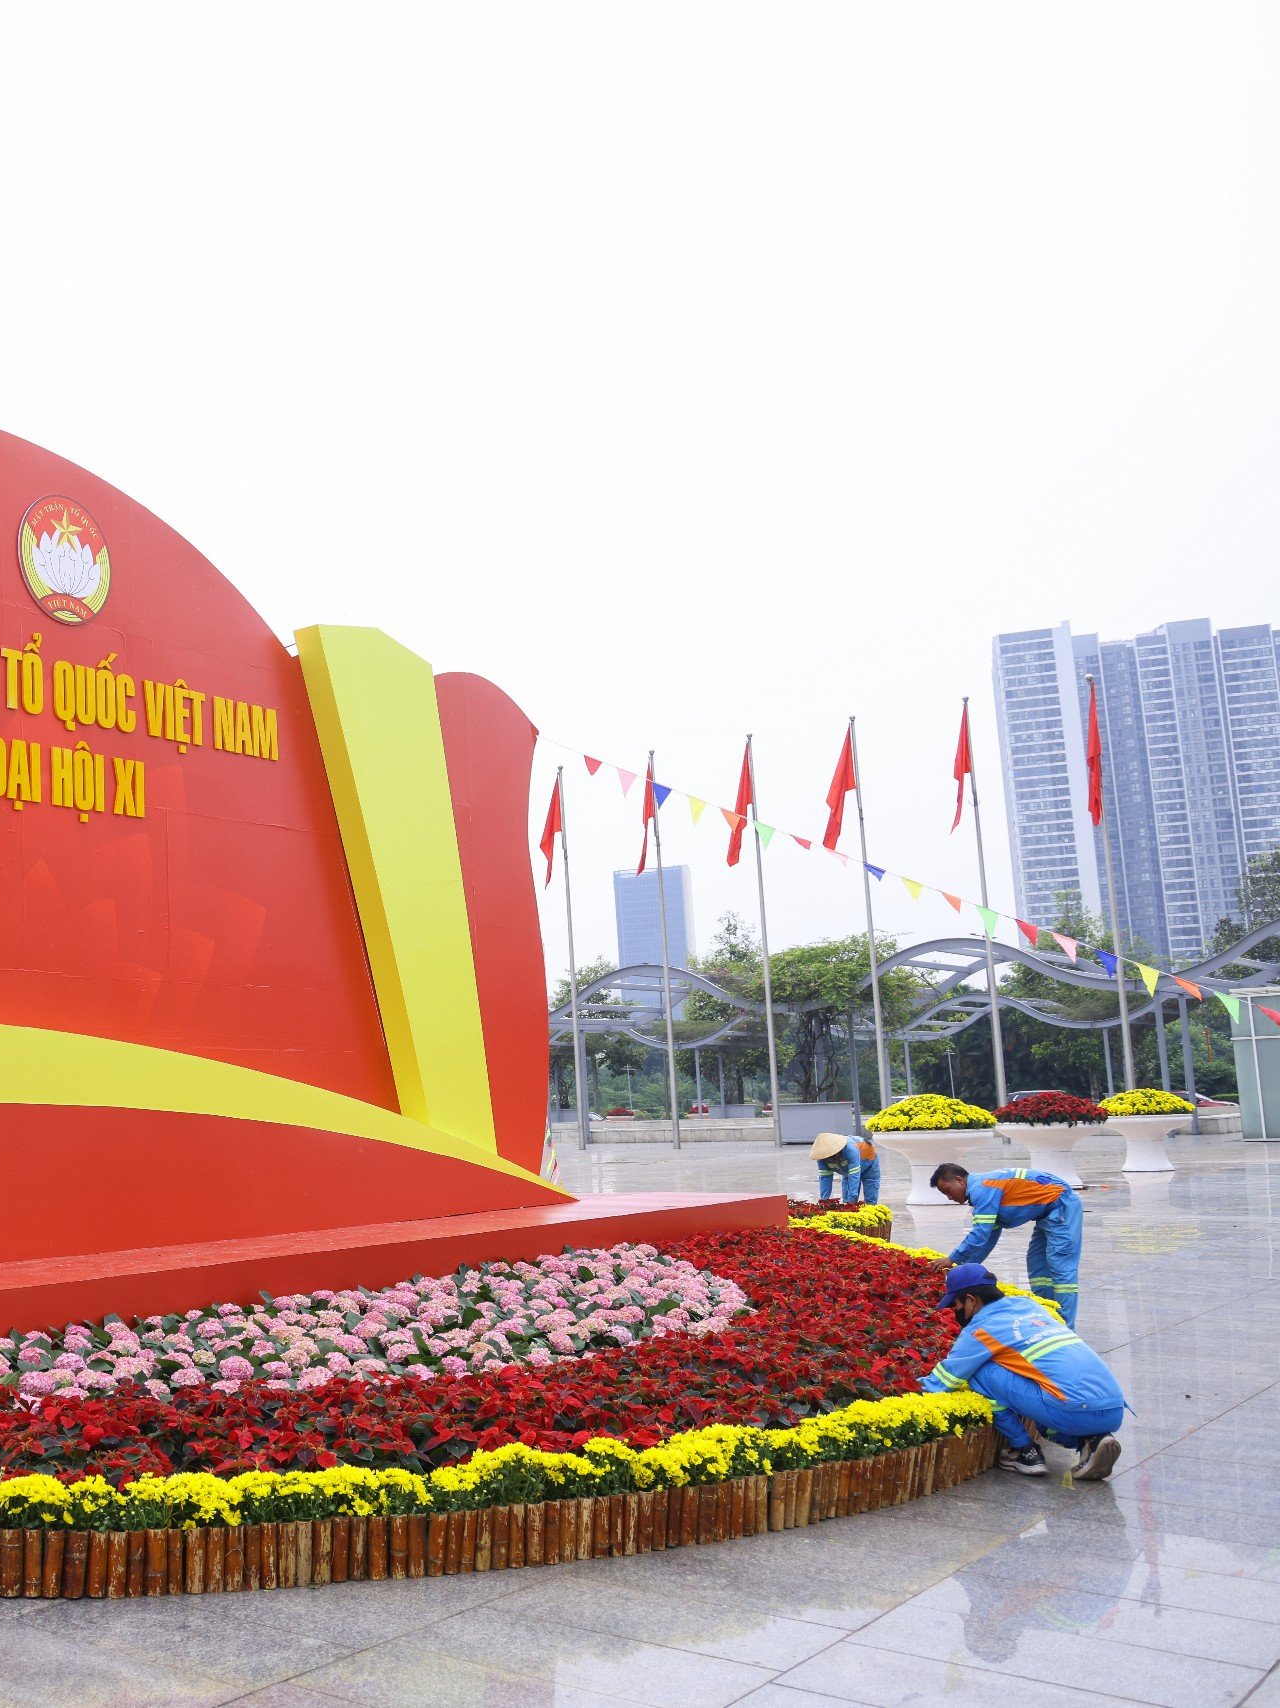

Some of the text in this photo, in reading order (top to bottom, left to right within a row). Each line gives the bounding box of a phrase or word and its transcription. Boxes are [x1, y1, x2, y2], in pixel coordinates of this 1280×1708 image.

[47, 597, 87, 618] VIỆT NAM
[0, 633, 44, 715] TỔ
[53, 652, 136, 732] QUỐC
[143, 679, 206, 754] VIỆT
[213, 696, 279, 761] NAM
[51, 740, 106, 823] HỘI
[113, 756, 145, 818] XI
